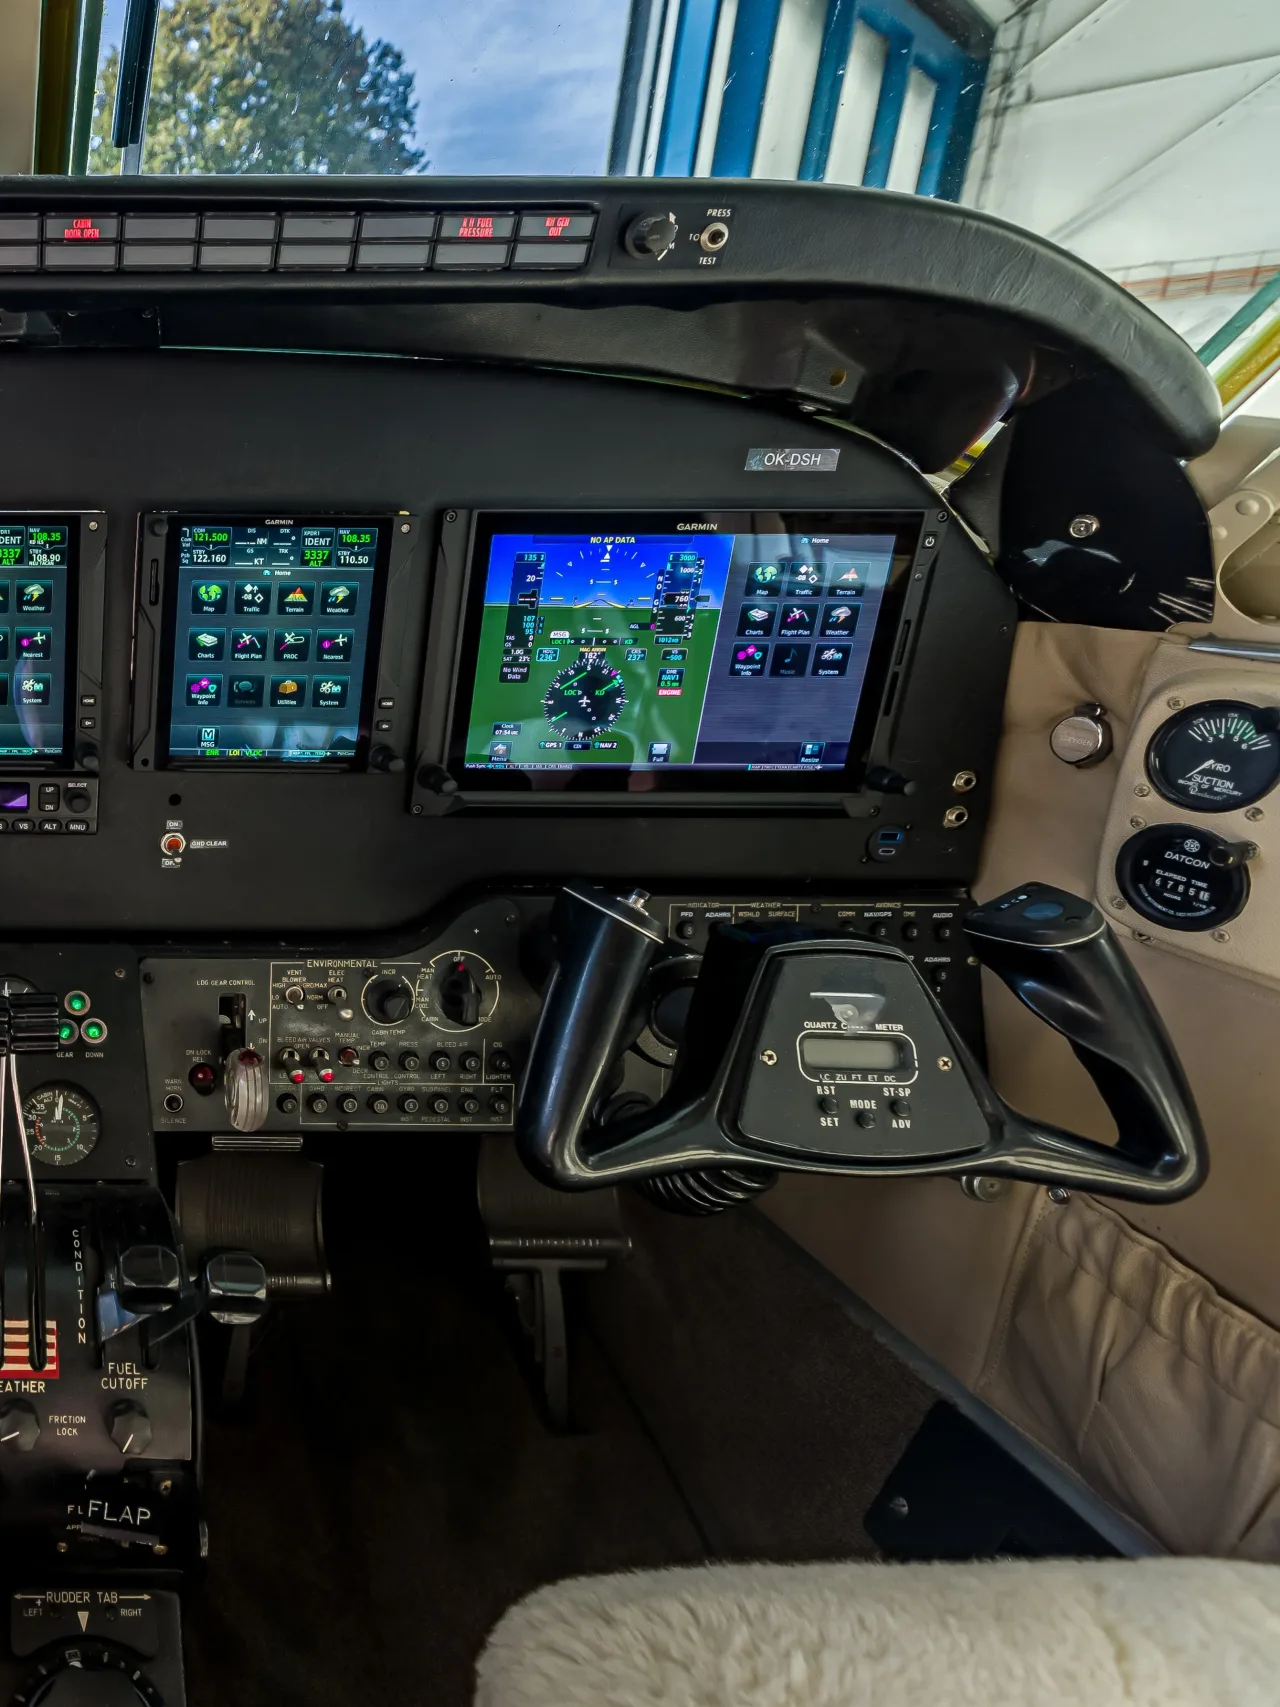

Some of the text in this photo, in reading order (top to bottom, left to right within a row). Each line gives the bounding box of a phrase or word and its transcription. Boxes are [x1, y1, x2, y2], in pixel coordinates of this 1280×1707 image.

[706, 209, 731, 217] PRESS
[72, 219, 91, 228] CABIN
[477, 218, 493, 228] FUEL
[545, 217, 571, 227] RH GEN
[64, 229, 99, 238] DOOR OPEN
[459, 227, 493, 237] PRESSURE
[549, 227, 562, 236] OUT
[689, 233, 700, 241] TO
[699, 257, 716, 265] TEST
[764, 453, 822, 465] OK-DSH
[32, 533, 61, 541] 108.35
[193, 533, 228, 541] 121.500
[342, 534, 370, 543] 108.35
[305, 538, 331, 546] IDENT
[32, 554, 61, 562] 108.90
[193, 554, 227, 563] 122.160
[304, 550, 329, 560] 3337
[340, 556, 369, 564] 110.50
[1192, 774, 1234, 789] SUCTION
[1164, 851, 1211, 870] DATCON
[307, 959, 378, 968] ENVIRONMENTAL
[804, 1021, 837, 1029] QUARTZ
[817, 1086, 835, 1095] RST
[883, 1088, 911, 1097] ST-SP
[850, 1100, 877, 1109] MODE
[820, 1117, 839, 1127] SET
[892, 1119, 911, 1129] ADV
[72, 1230, 86, 1344] CONDITION
[108, 1363, 140, 1375] FUEL
[101, 1378, 148, 1390] CUTOFF
[49, 1415, 86, 1424] FRICTION
[56, 1428, 78, 1436] LOCK
[88, 1500, 151, 1526] FLAP
[46, 1591, 119, 1604] RUDDER TAB
[120, 1608, 142, 1617] RIGHT
